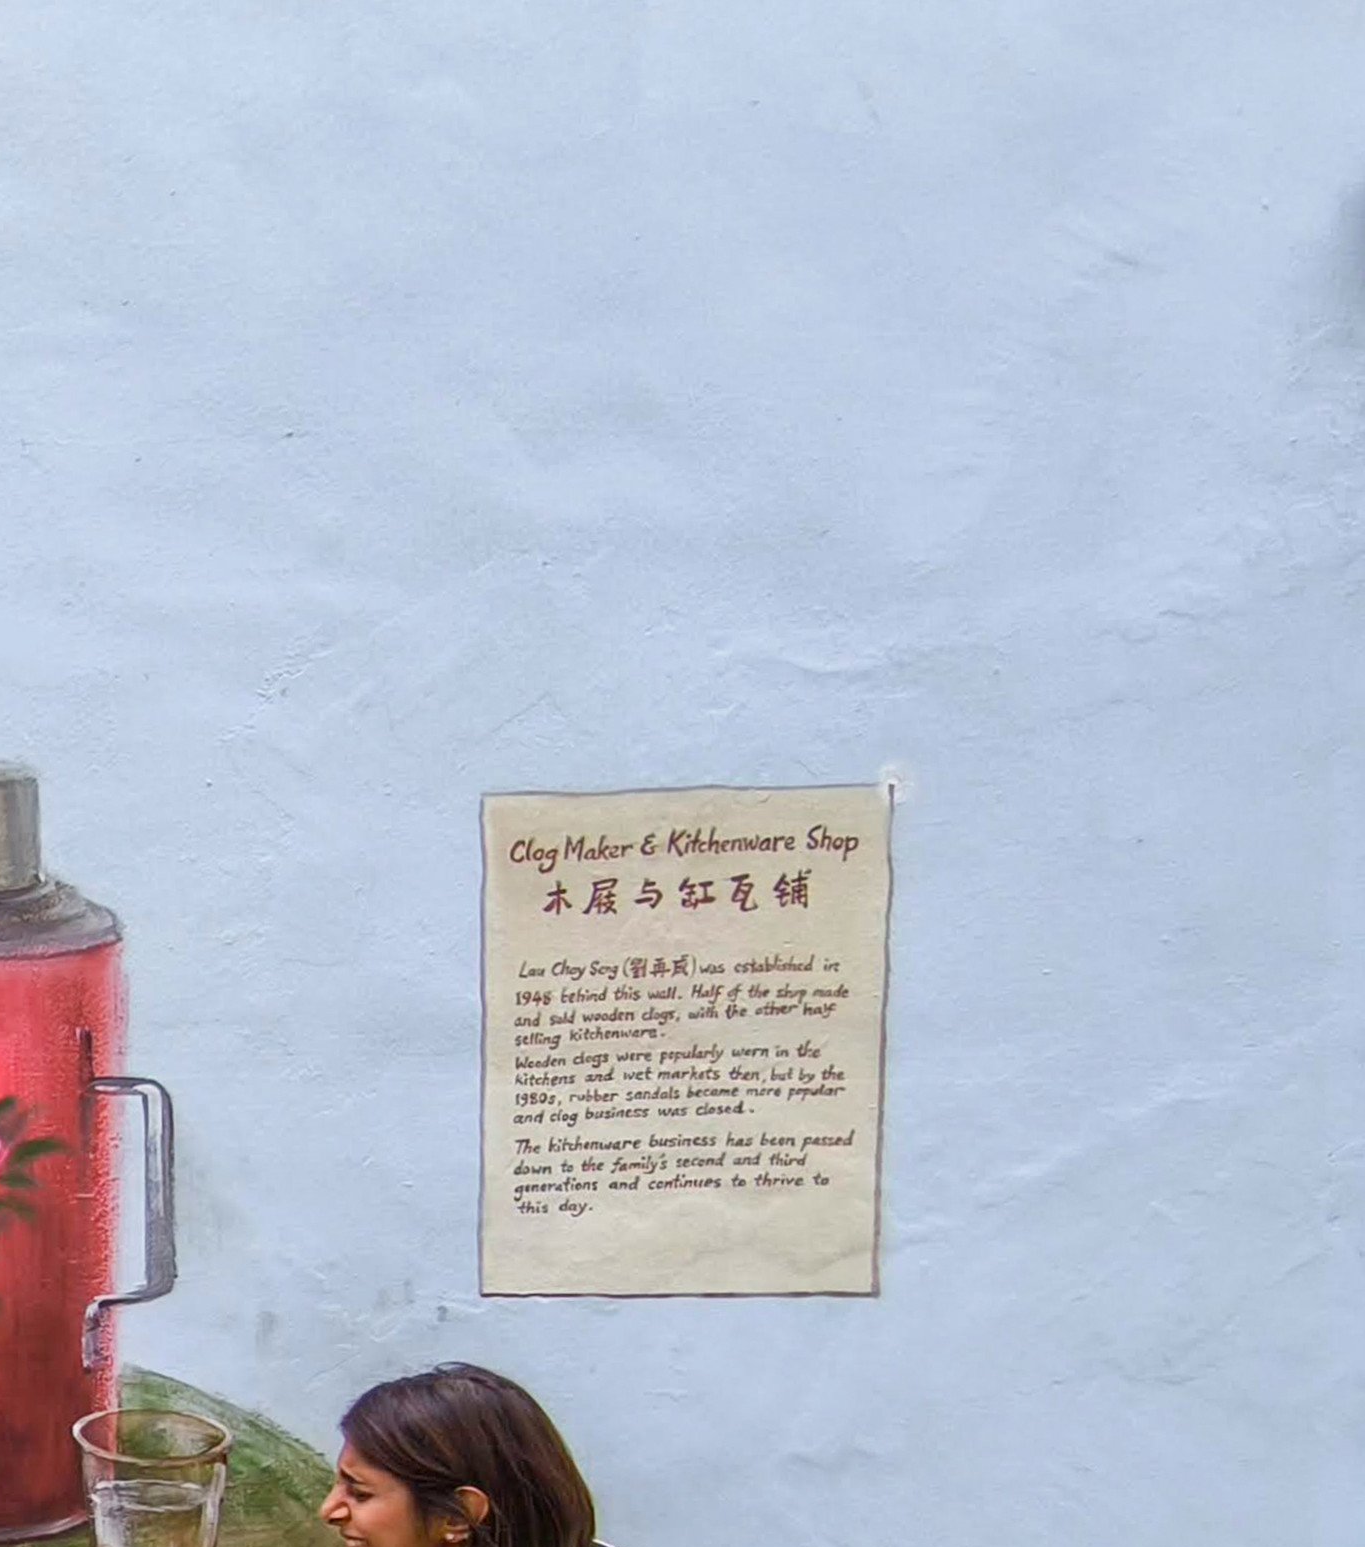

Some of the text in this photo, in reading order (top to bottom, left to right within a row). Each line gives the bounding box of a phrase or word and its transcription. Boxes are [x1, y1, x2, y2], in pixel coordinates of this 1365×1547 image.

[509, 824, 860, 875] Clog Maker & Kitchenware Shop
[700, 963, 725, 973] was
[734, 955, 814, 973] established
[561, 987, 608, 1003] behind
[614, 985, 641, 1001] this
[692, 984, 724, 1004] Half
[727, 983, 742, 1002] of
[748, 984, 769, 998] the
[776, 983, 806, 1004] shop
[812, 984, 849, 998] made
[514, 1012, 541, 1027] and
[550, 1010, 575, 1026] sold
[582, 1008, 634, 1022] wooden
[688, 1005, 718, 1020] with
[726, 1004, 747, 1019] the
[755, 1001, 798, 1016] other
[803, 1002, 836, 1018] half
[515, 1032, 562, 1050] selling
[515, 1040, 821, 1070] Wooden clogs were popularly worn in the
[515, 1072, 575, 1087] kitchens
[585, 1068, 615, 1082] and
[623, 1069, 652, 1080] wet
[657, 1066, 720, 1080] markets
[770, 1068, 793, 1081] but
[799, 1068, 815, 1084] by
[822, 1064, 845, 1080] the
[569, 1090, 619, 1102] rubber
[625, 1086, 680, 1101] sandals
[687, 1086, 739, 1098] became
[746, 1087, 781, 1096] more
[787, 1085, 845, 1101] popular
[513, 1110, 544, 1124] and
[550, 1111, 578, 1127] clog
[585, 1107, 649, 1120] business
[658, 1106, 688, 1117] was
[515, 1129, 855, 1155] The kitchenware business has been passed
[514, 1152, 807, 1175] down to the family's second and third
[514, 1171, 830, 1201] generations and continues to thrive to
[517, 1198, 593, 1217] this day.
